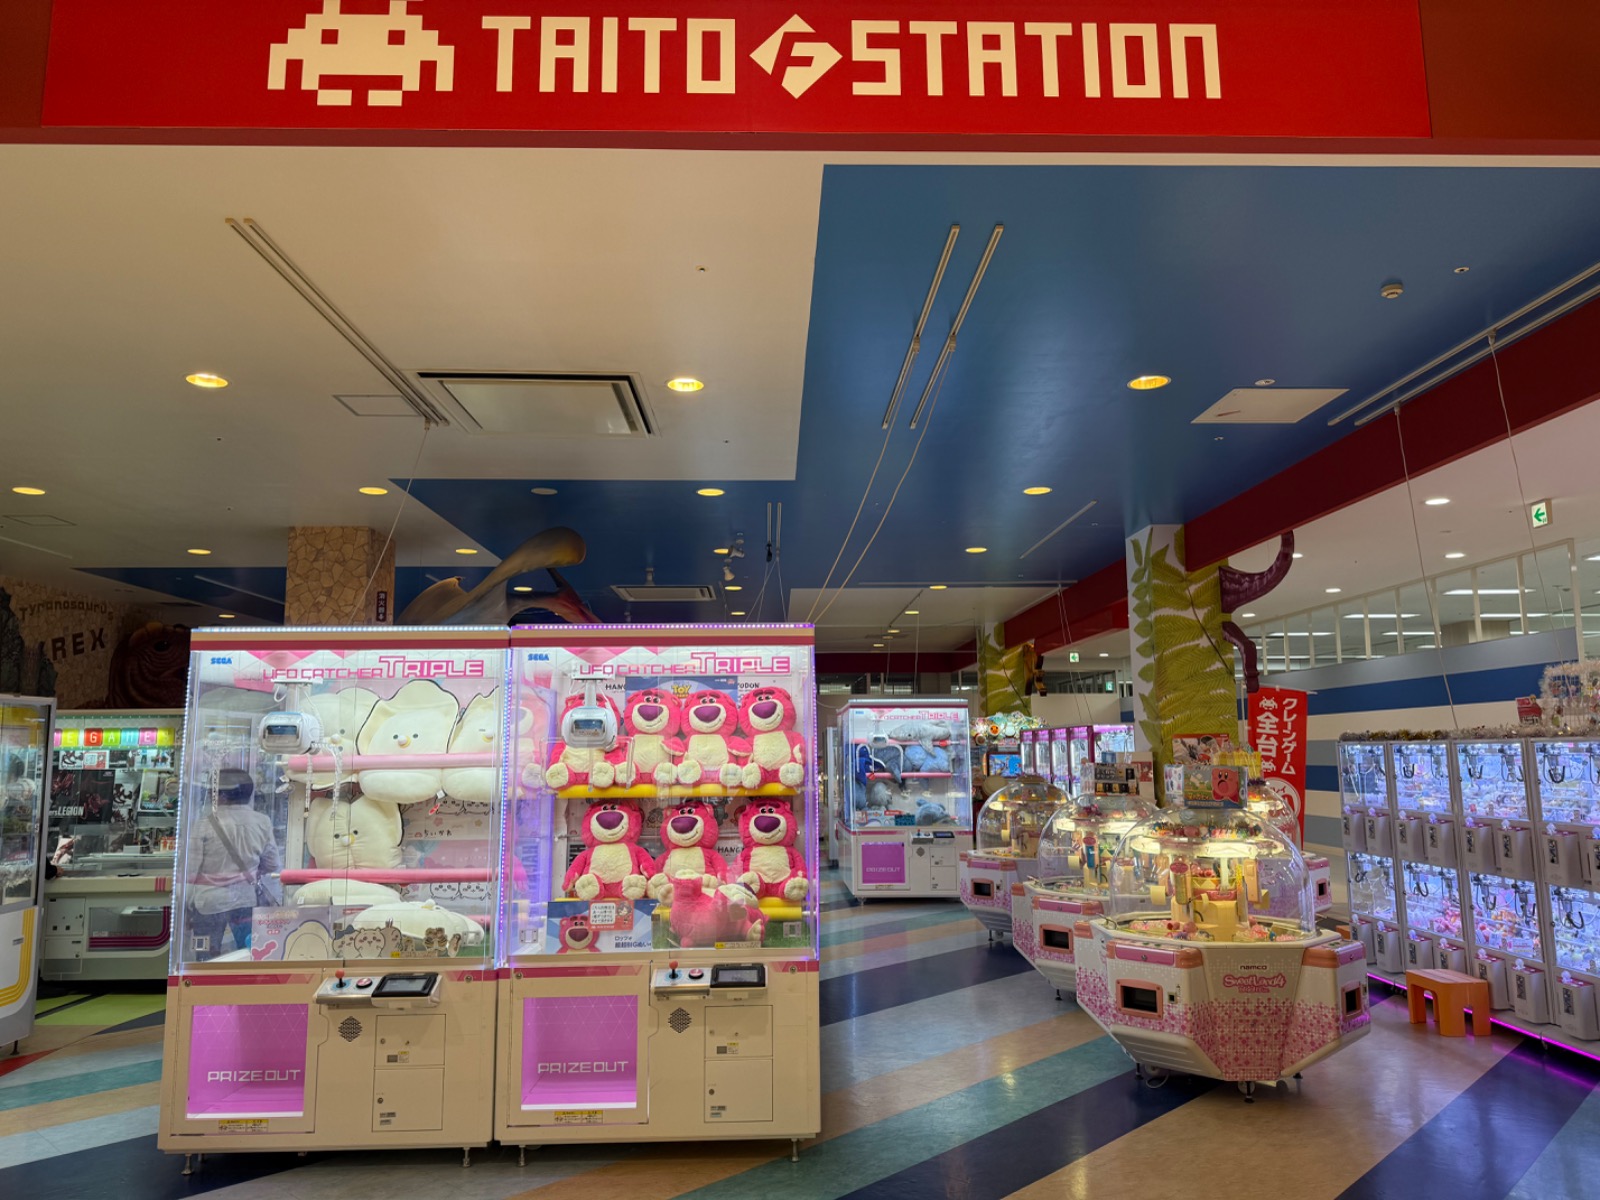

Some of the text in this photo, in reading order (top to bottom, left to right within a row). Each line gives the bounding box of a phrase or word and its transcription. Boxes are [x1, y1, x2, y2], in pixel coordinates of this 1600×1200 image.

[482, 16, 736, 95] TAITO
[851, 19, 1223, 100] STATION
[19, 600, 114, 621] Tyranosaurus
[51, 627, 106, 661] REX
[211, 657, 232, 665] SEGA
[263, 656, 484, 679] UFO CATCHER TRIPLE
[528, 653, 550, 661] SEGA
[579, 652, 791, 675] UFO CATCHER TRIPLE
[671, 684, 692, 694] TOY
[1256, 712, 1279, 758] 全台
[1281, 698, 1298, 775] クレーンゲーム
[57, 806, 85, 816] LEGION
